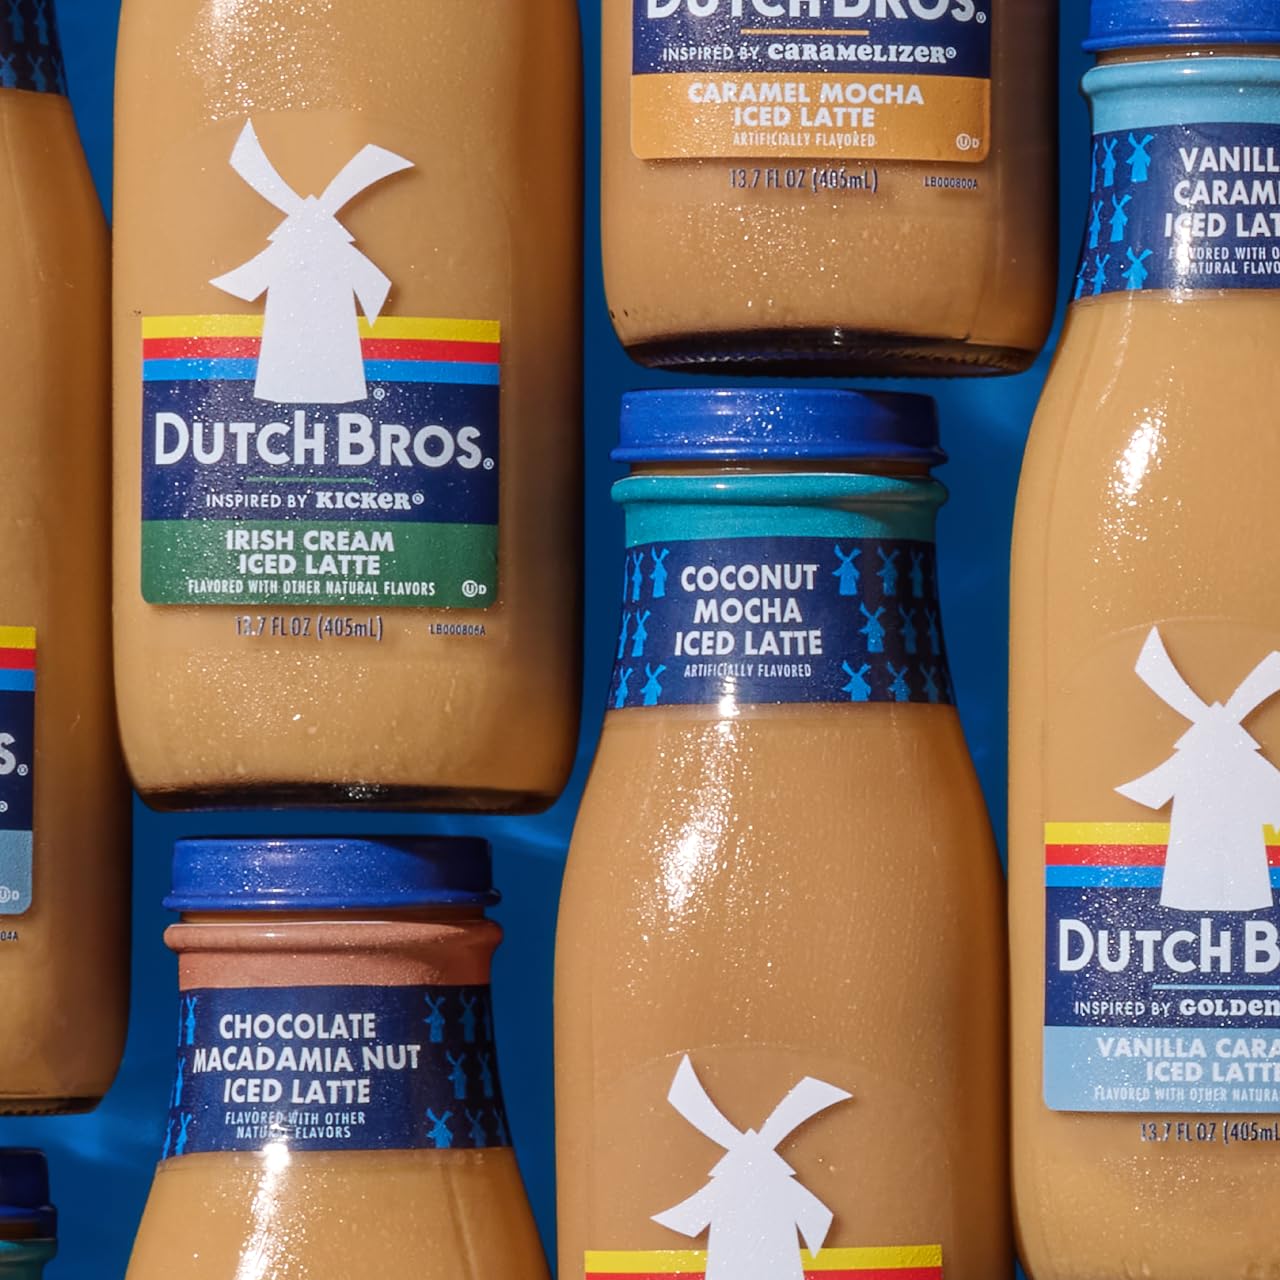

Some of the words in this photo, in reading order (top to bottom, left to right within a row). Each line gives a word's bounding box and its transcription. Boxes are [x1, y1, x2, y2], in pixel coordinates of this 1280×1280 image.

[662, 47, 733, 61] INSPIRED
[738, 47, 758, 60] BY
[688, 82, 810, 104] CARAMEL
[820, 83, 924, 105] MOCHA
[734, 107, 790, 127] ICED
[800, 108, 874, 128] LATTE
[1165, 213, 1226, 237] ICED
[206, 493, 281, 509] INSPIRED
[287, 493, 307, 508] BY
[225, 531, 294, 551] IRISH
[303, 530, 395, 551] CREAM
[238, 555, 297, 575] ICED
[305, 555, 380, 575] LATTE
[188, 579, 244, 594] FLAVORED
[248, 579, 278, 595] WITH
[283, 580, 322, 595] OTHER
[326, 580, 379, 596] NATURAL
[384, 580, 436, 596] FLAVORS
[681, 564, 819, 591] COCONUT
[693, 598, 802, 623] MOCHA
[675, 631, 733, 656] ICED
[745, 630, 822, 655] LATTE
[684, 664, 753, 677] ARTIFICIALLY
[758, 664, 811, 677] FLAVORED
[1075, 1002, 1145, 1015] INSPIRED
[1152, 1002, 1170, 1015] BY
[219, 1014, 375, 1039] CHOCOLATE
[1097, 1038, 1206, 1058] VANILLA
[193, 1047, 353, 1073] MACADAMIA
[364, 1045, 420, 1071] NUT
[1146, 1062, 1202, 1082] ICED
[224, 1079, 282, 1103] ICED
[292, 1079, 370, 1104] LATTE
